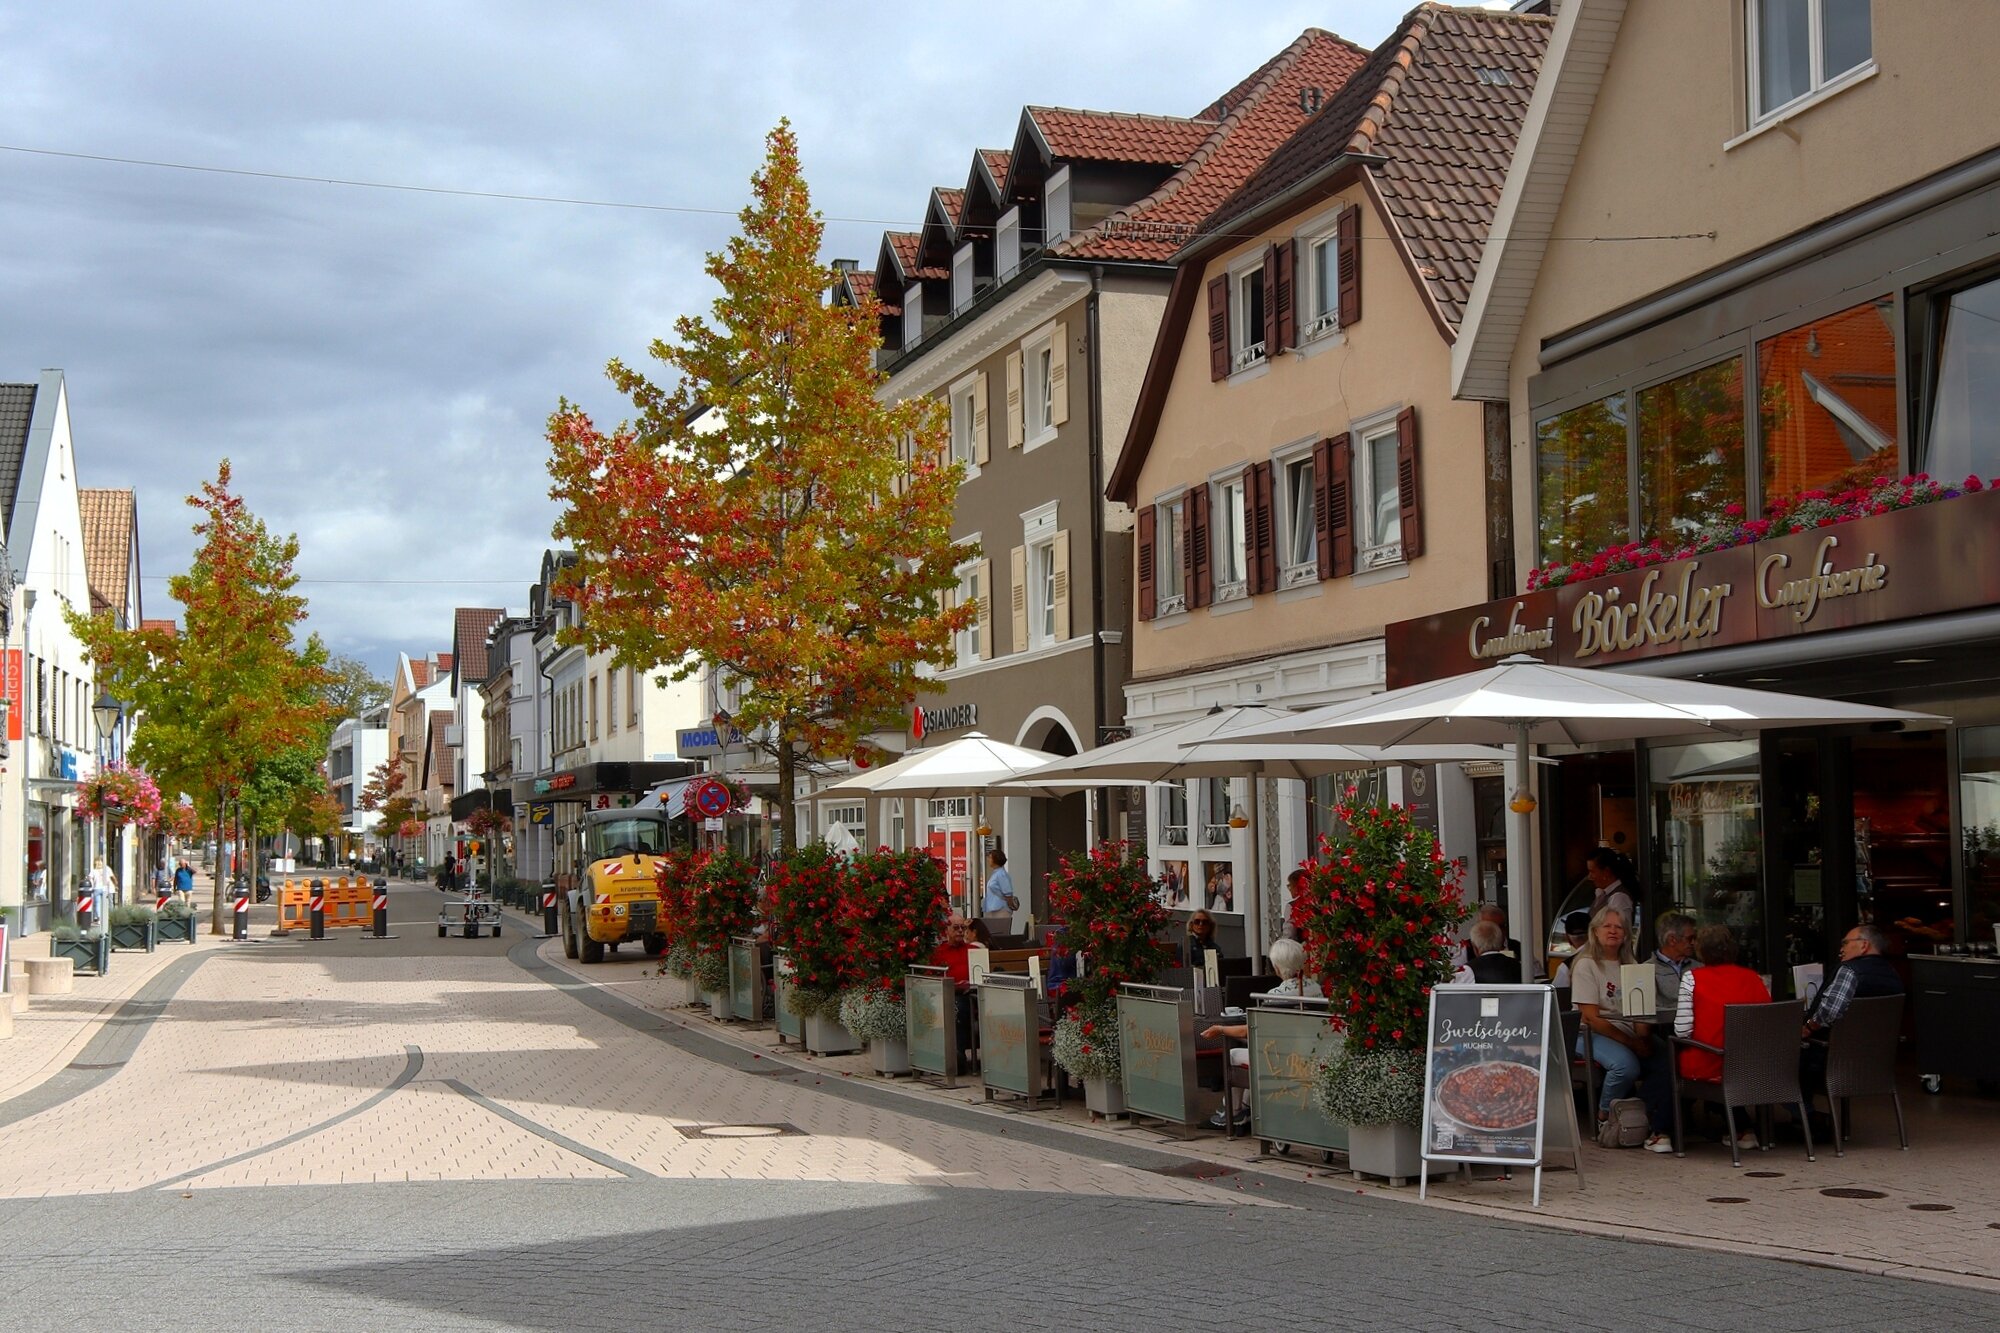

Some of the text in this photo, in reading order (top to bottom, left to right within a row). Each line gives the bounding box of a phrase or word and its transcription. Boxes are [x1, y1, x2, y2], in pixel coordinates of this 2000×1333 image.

[1572, 561, 1732, 659] Böckeler
[1756, 535, 1887, 623] Confiserie
[923, 703, 973, 732] OSIANDER
[615, 906, 625, 915] 20
[1462, 1042, 1494, 1050] KUCHEN
